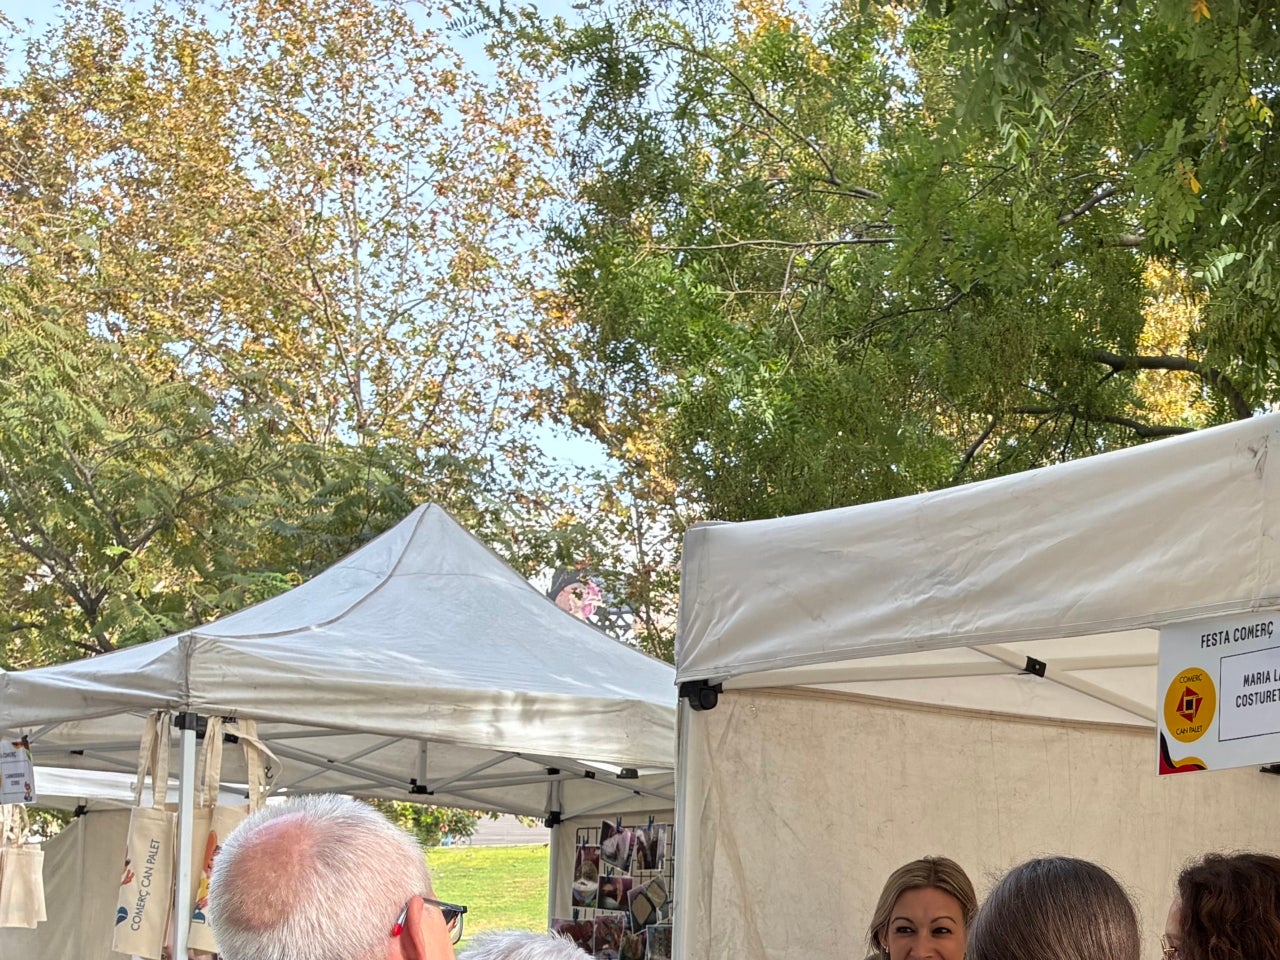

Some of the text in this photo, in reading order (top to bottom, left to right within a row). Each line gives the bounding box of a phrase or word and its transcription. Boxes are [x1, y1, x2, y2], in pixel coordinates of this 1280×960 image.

[1201, 621, 1274, 648] FESTA COMERÇ
[1243, 670, 1271, 687] MARIA
[1176, 727, 1188, 736] CAN
[130, 838, 161, 931] COMERÇ CAN PALET
